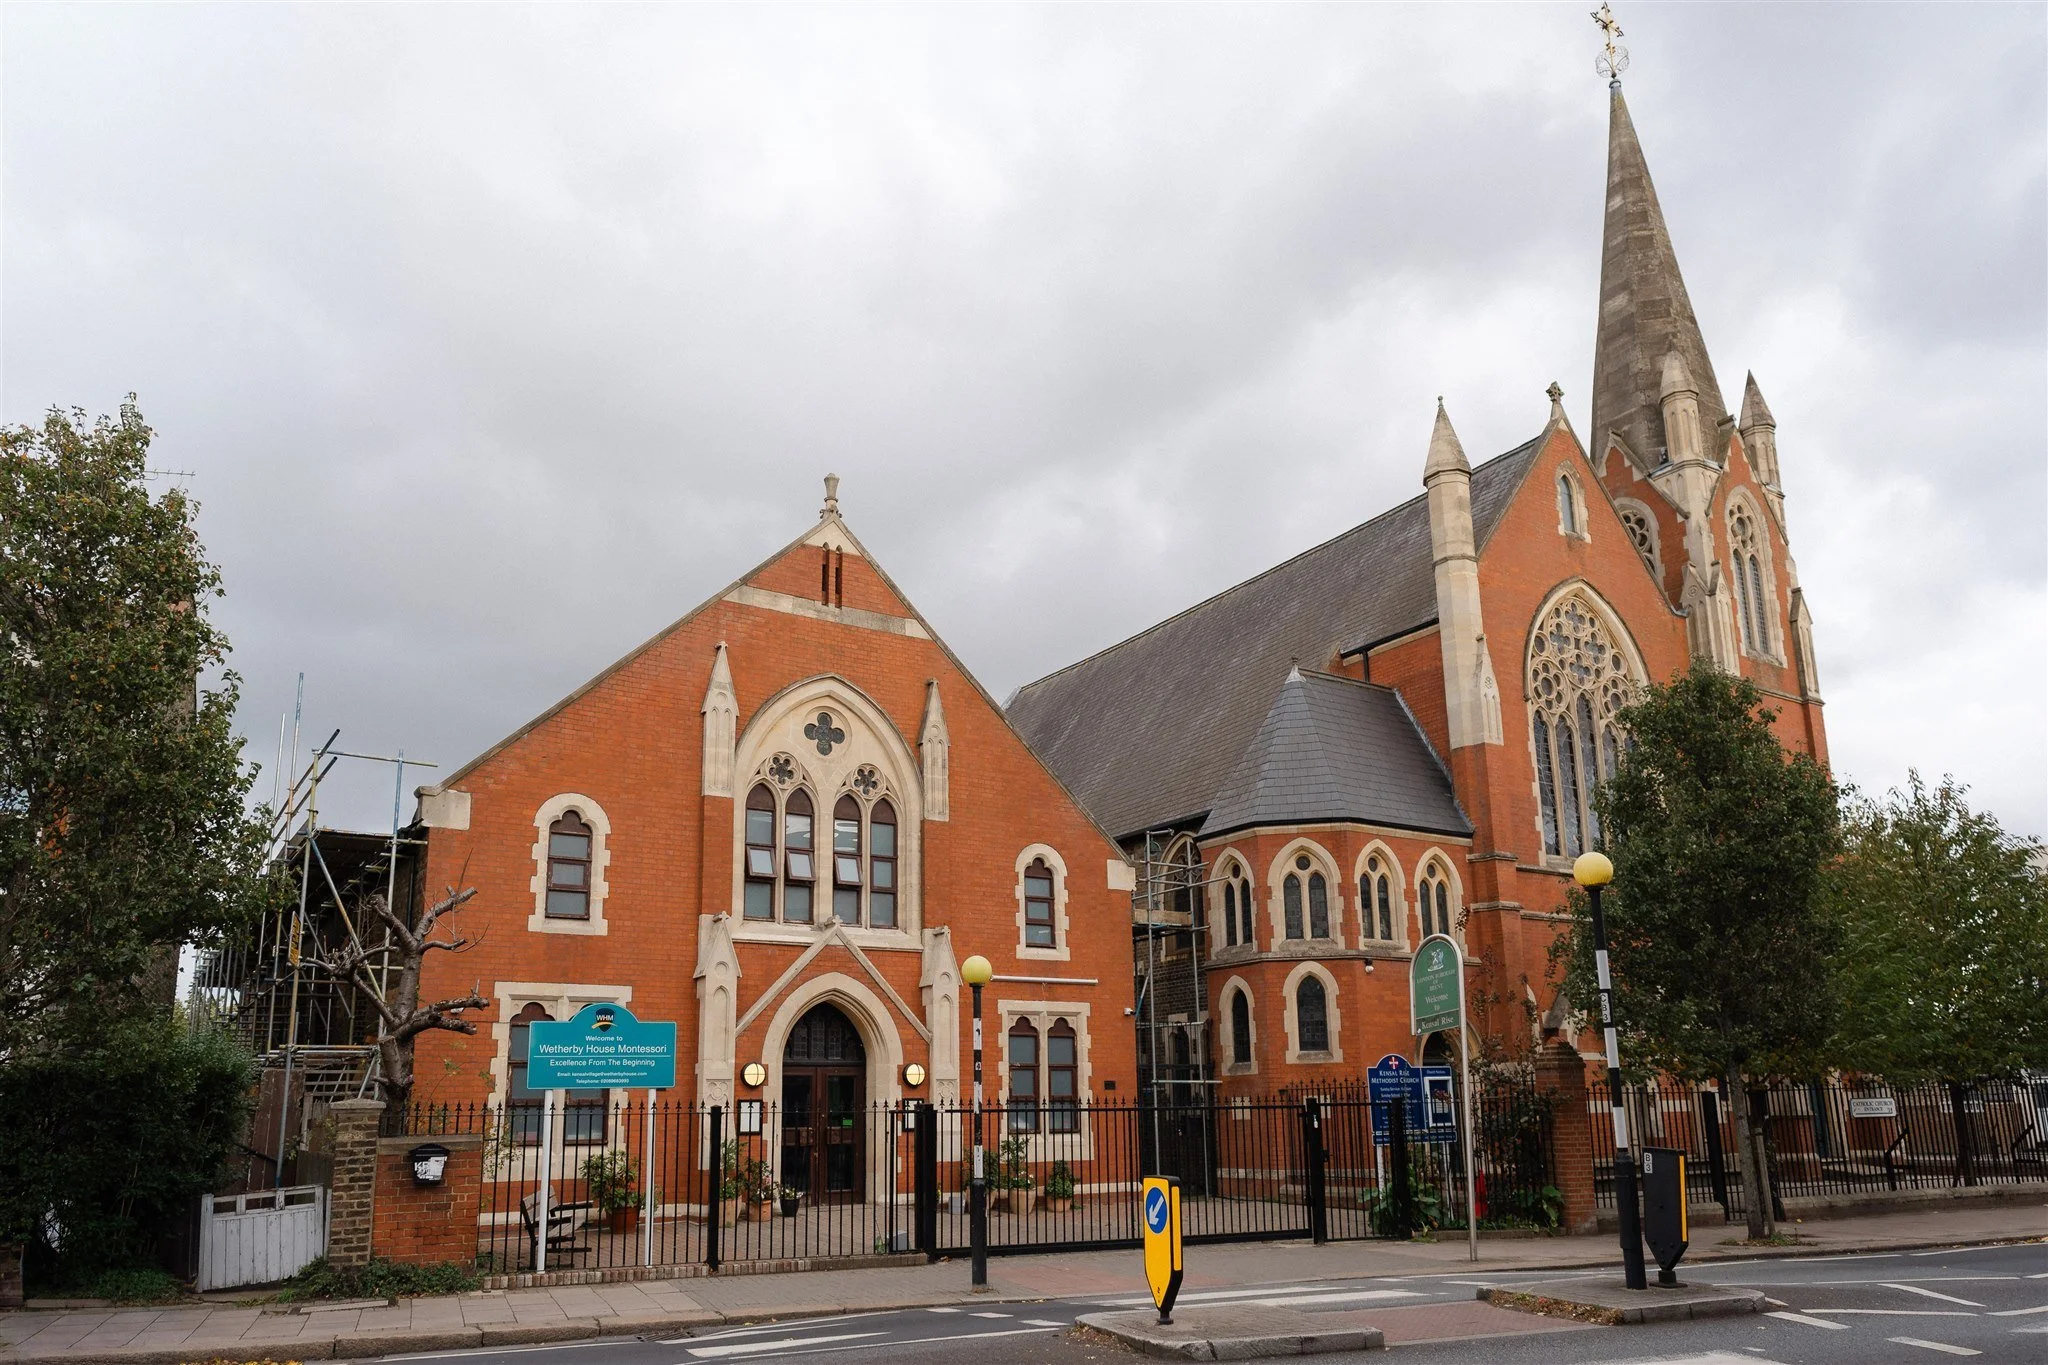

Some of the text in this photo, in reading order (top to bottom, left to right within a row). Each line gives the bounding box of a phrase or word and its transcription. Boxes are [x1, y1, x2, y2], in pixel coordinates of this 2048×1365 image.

[1425, 994, 1448, 1004] Welcome
[1422, 1016, 1454, 1029] Kensal Rise
[539, 1044, 667, 1055] Wetherby House Montessori
[588, 1058, 606, 1066] From
[608, 1058, 621, 1066] The
[622, 1058, 656, 1067] Beginning
